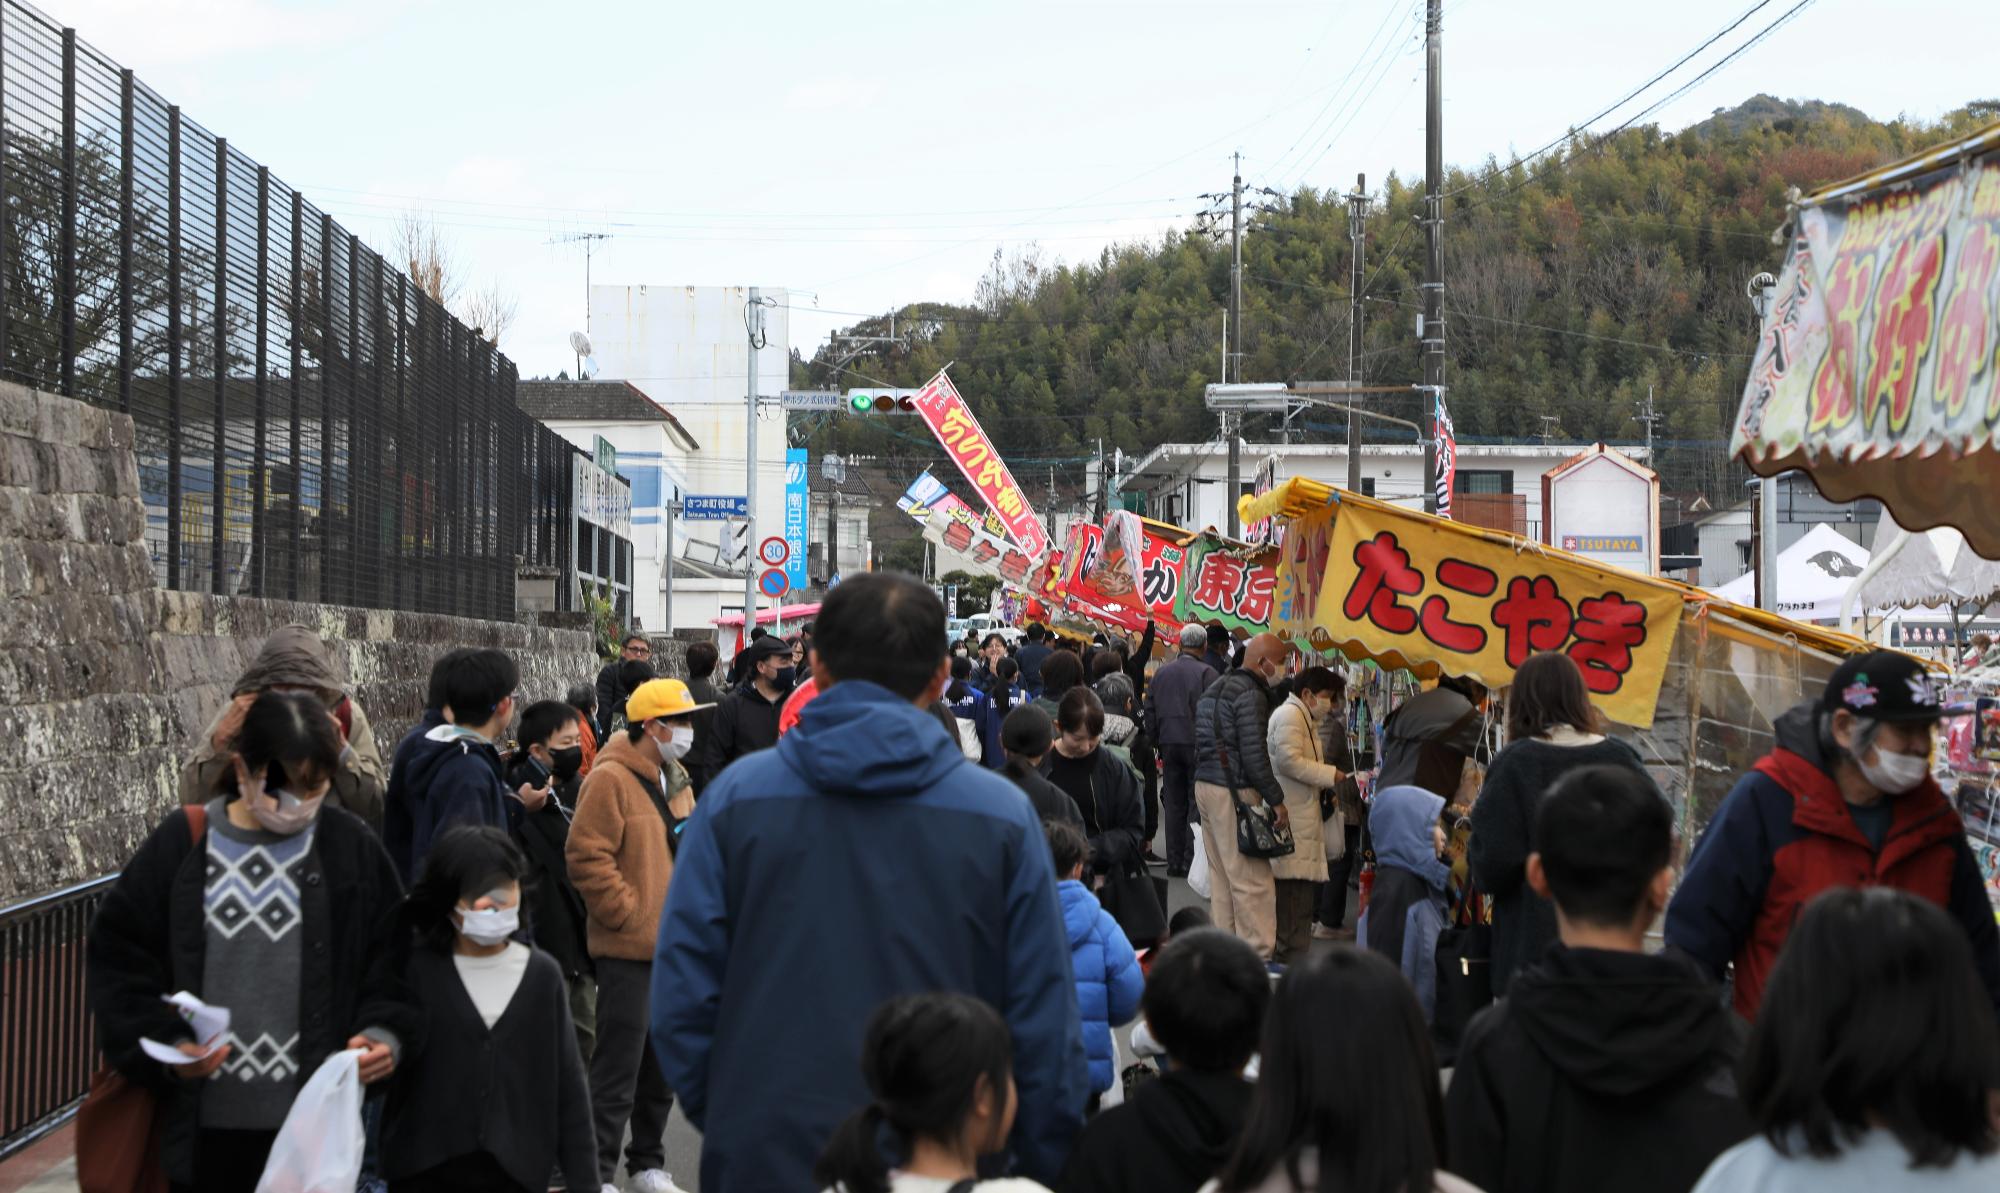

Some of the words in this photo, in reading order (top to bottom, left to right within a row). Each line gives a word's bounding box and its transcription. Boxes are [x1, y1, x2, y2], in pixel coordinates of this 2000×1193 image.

[1806, 220, 2000, 434] お好み
[687, 498, 735, 510] さつま町役場
[766, 544, 783, 559] 30
[787, 492, 803, 572] 南日本銀行
[1580, 538, 1638, 550] TSUTAYA
[1342, 530, 1648, 694] たこやき
